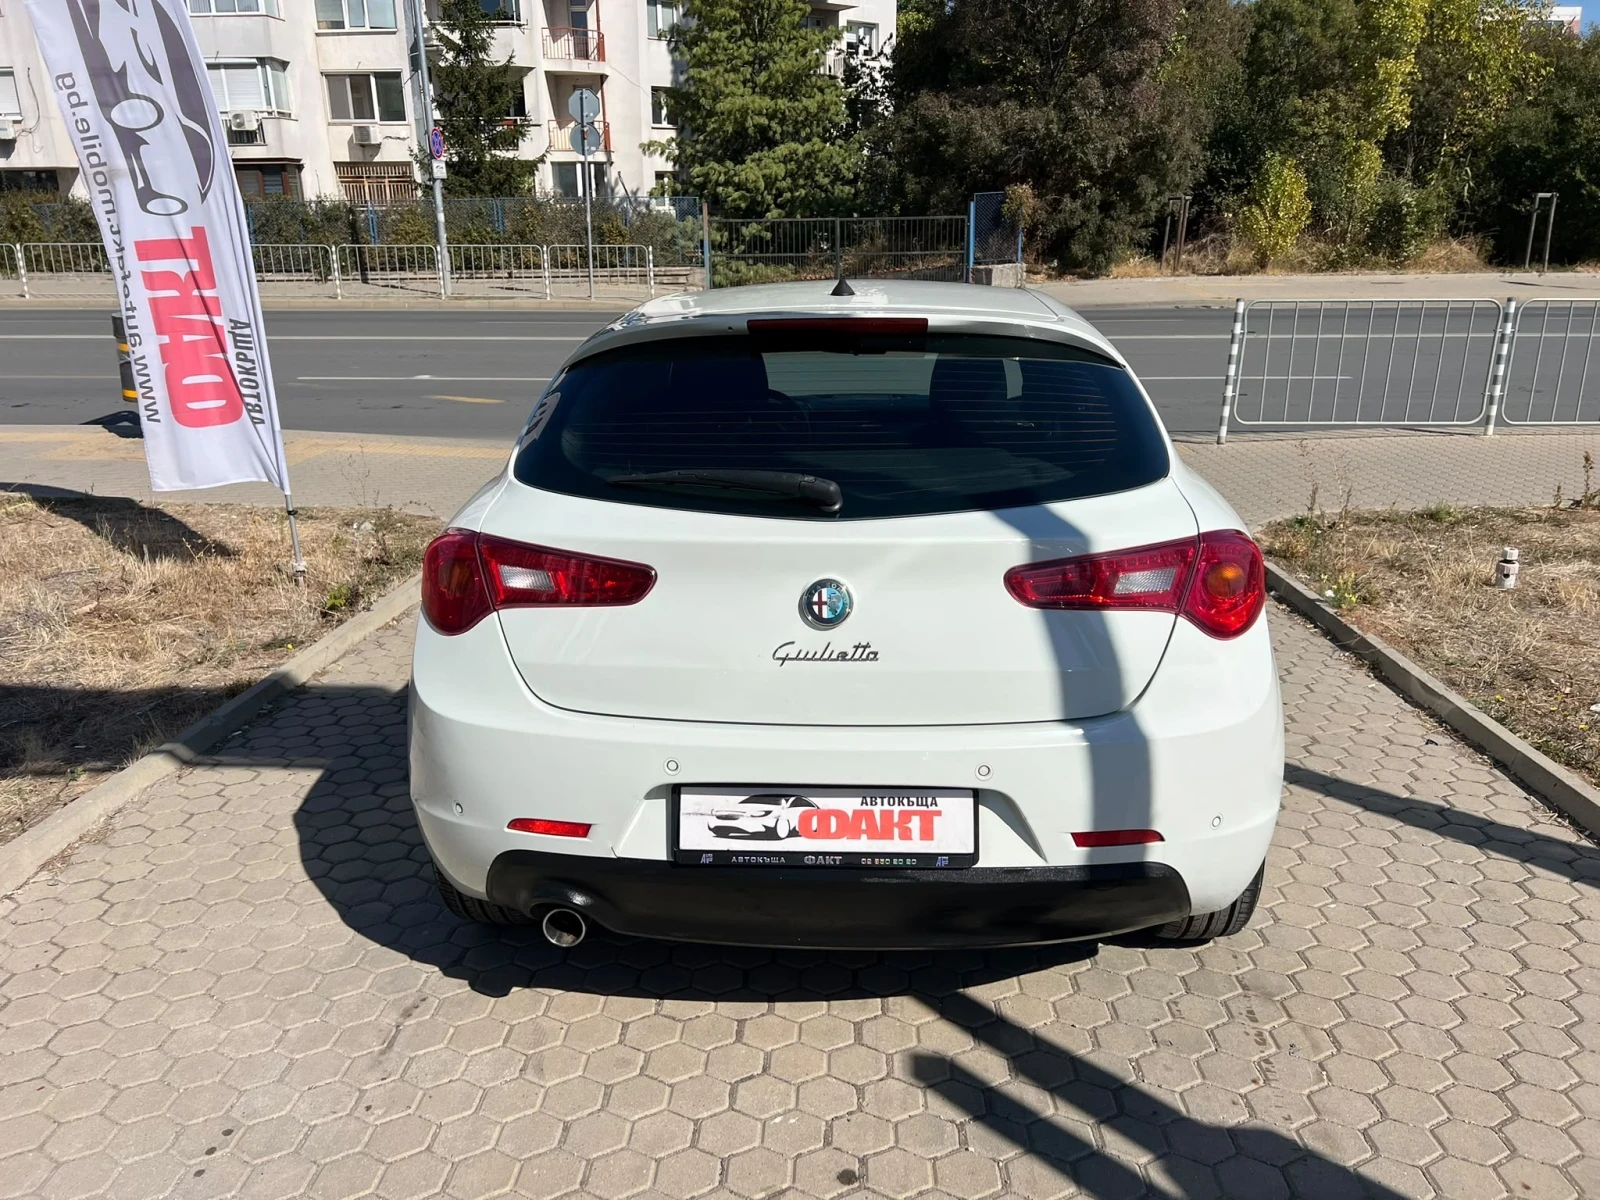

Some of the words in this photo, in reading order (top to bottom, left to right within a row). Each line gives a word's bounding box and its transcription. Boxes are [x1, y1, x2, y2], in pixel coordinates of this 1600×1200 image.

[772, 641, 879, 667] Giulietta
[860, 796, 938, 808] АВТОКЪЩА
[798, 809, 942, 841] ФАКТ
[804, 855, 842, 865] ФАКТ
